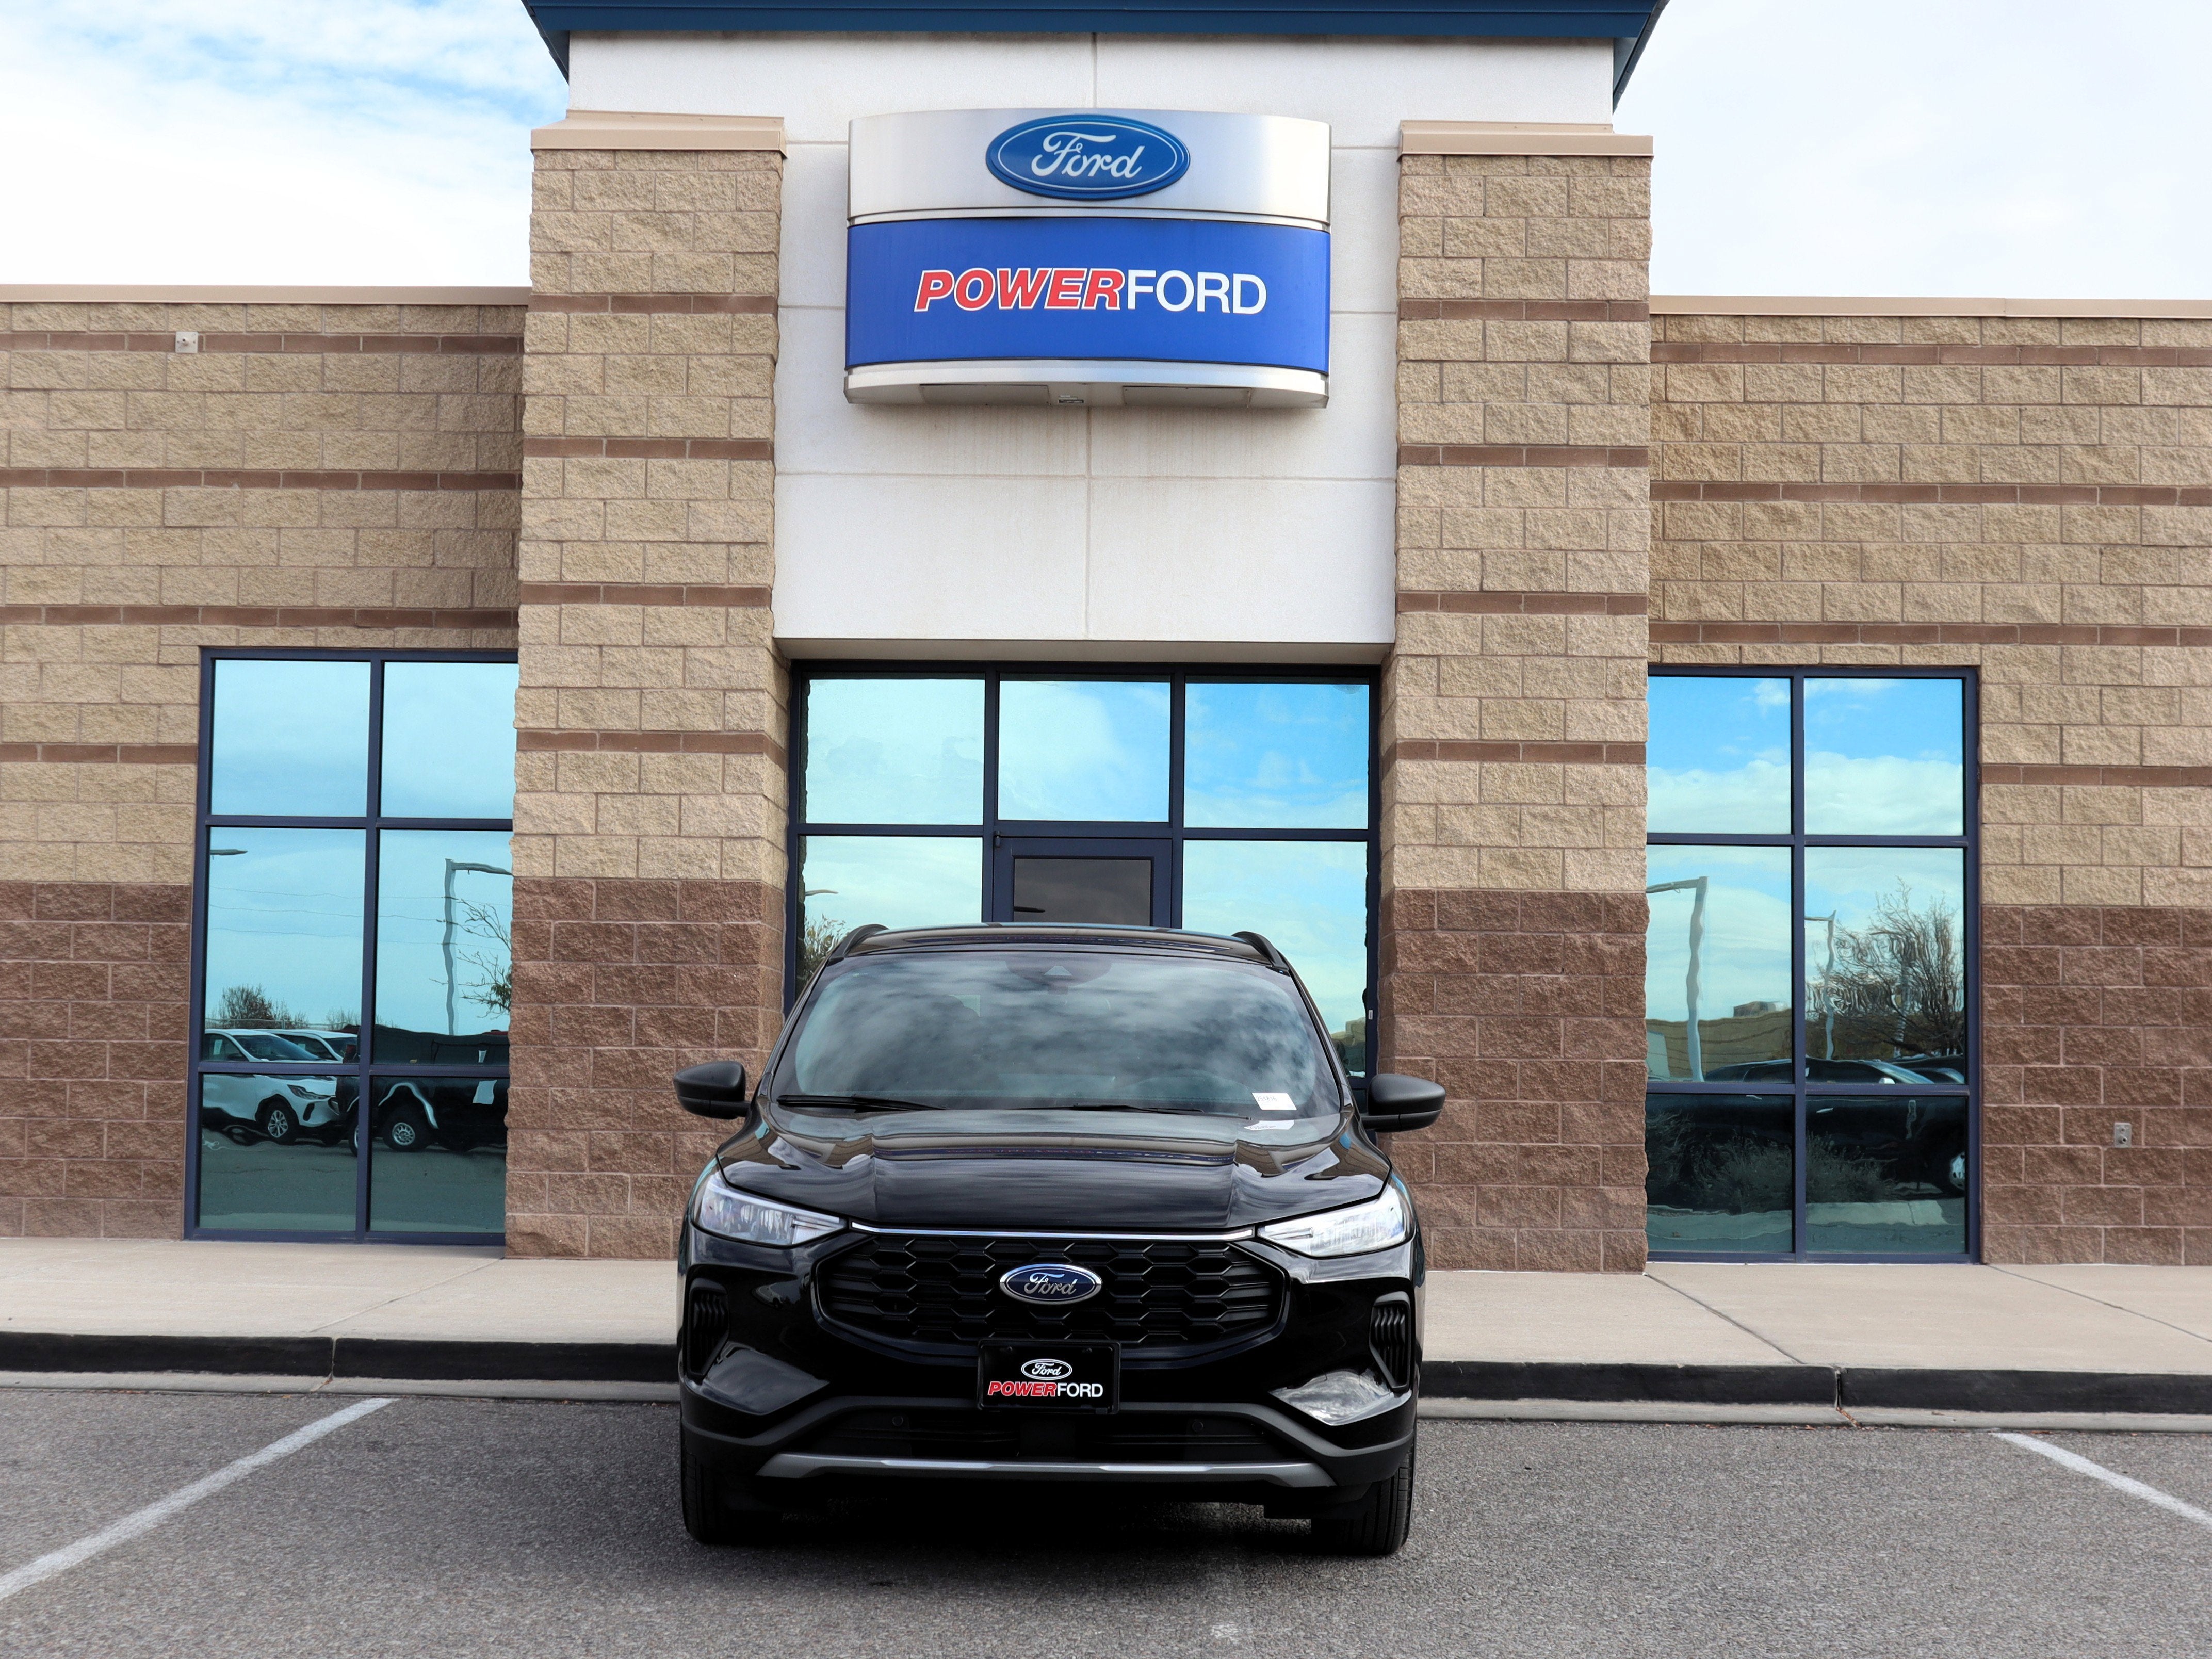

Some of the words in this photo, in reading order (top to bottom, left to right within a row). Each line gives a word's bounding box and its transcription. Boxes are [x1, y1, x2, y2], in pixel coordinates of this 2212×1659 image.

[1031, 131, 1144, 178] Ford
[1024, 1272, 1078, 1294] Ford
[1031, 1362, 1061, 1376] Ford
